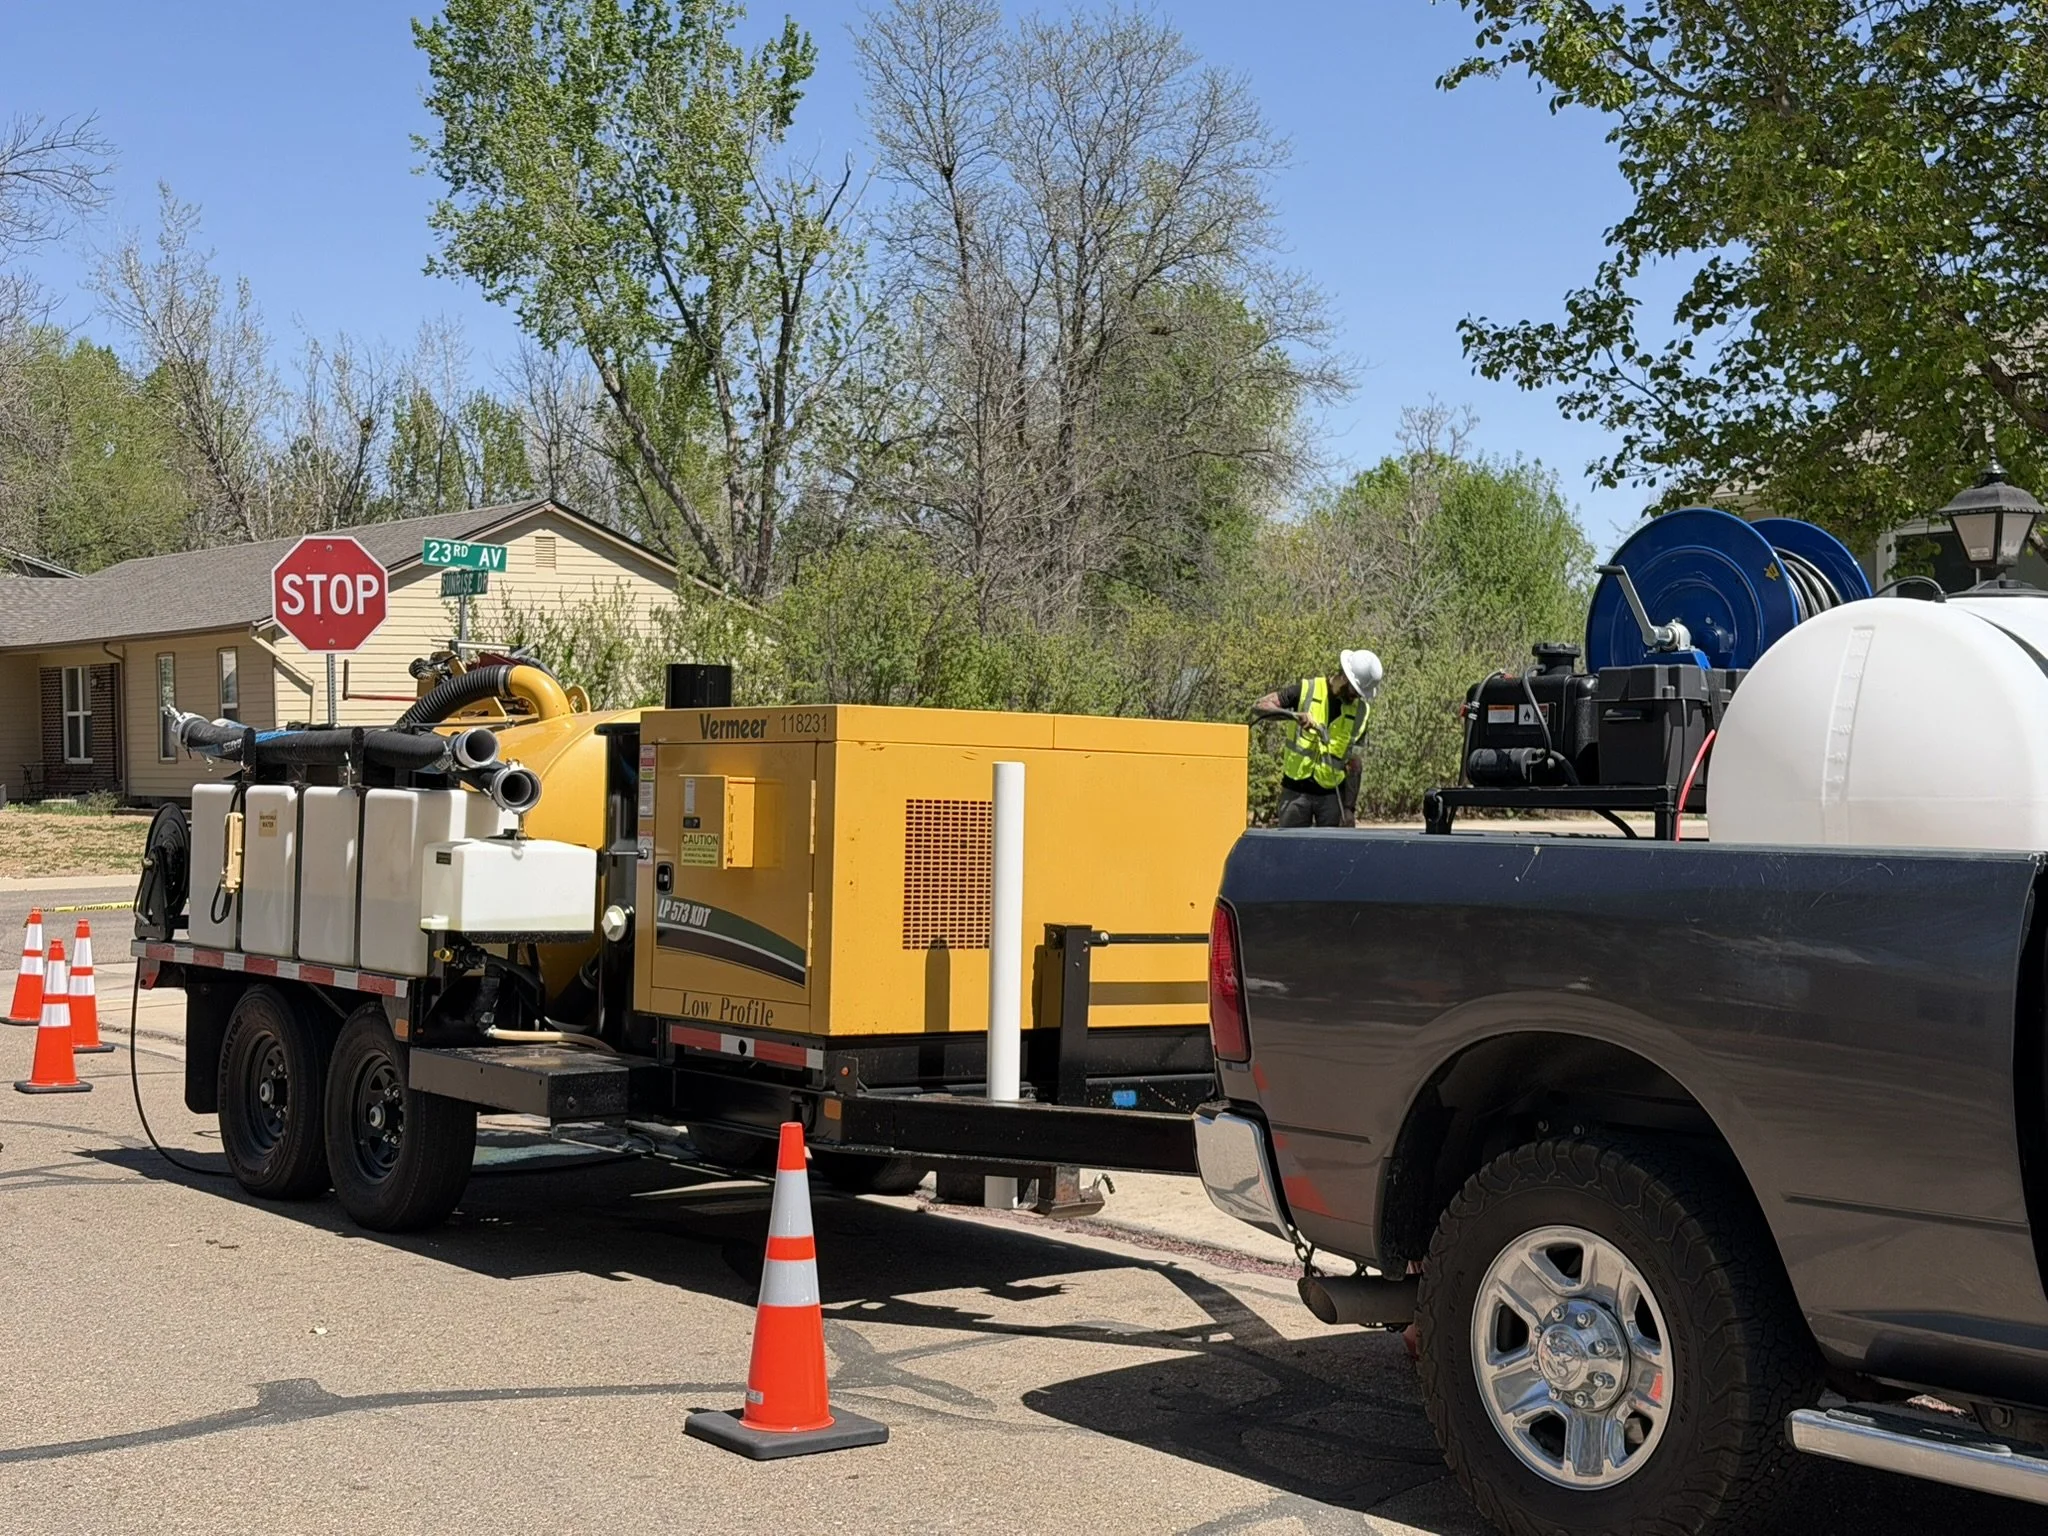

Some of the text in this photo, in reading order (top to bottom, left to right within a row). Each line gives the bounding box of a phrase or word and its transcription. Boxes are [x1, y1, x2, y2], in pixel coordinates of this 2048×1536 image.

[428, 541, 502, 569] 23RD AV
[282, 573, 380, 616] STOP
[441, 572, 488, 595] SUNRISE DR
[699, 713, 767, 739] Vermeer
[781, 713, 827, 733] 118231
[682, 834, 718, 846] CAUTION
[658, 898, 712, 928] LP 573 XDT
[681, 992, 774, 1027] Low Profile
